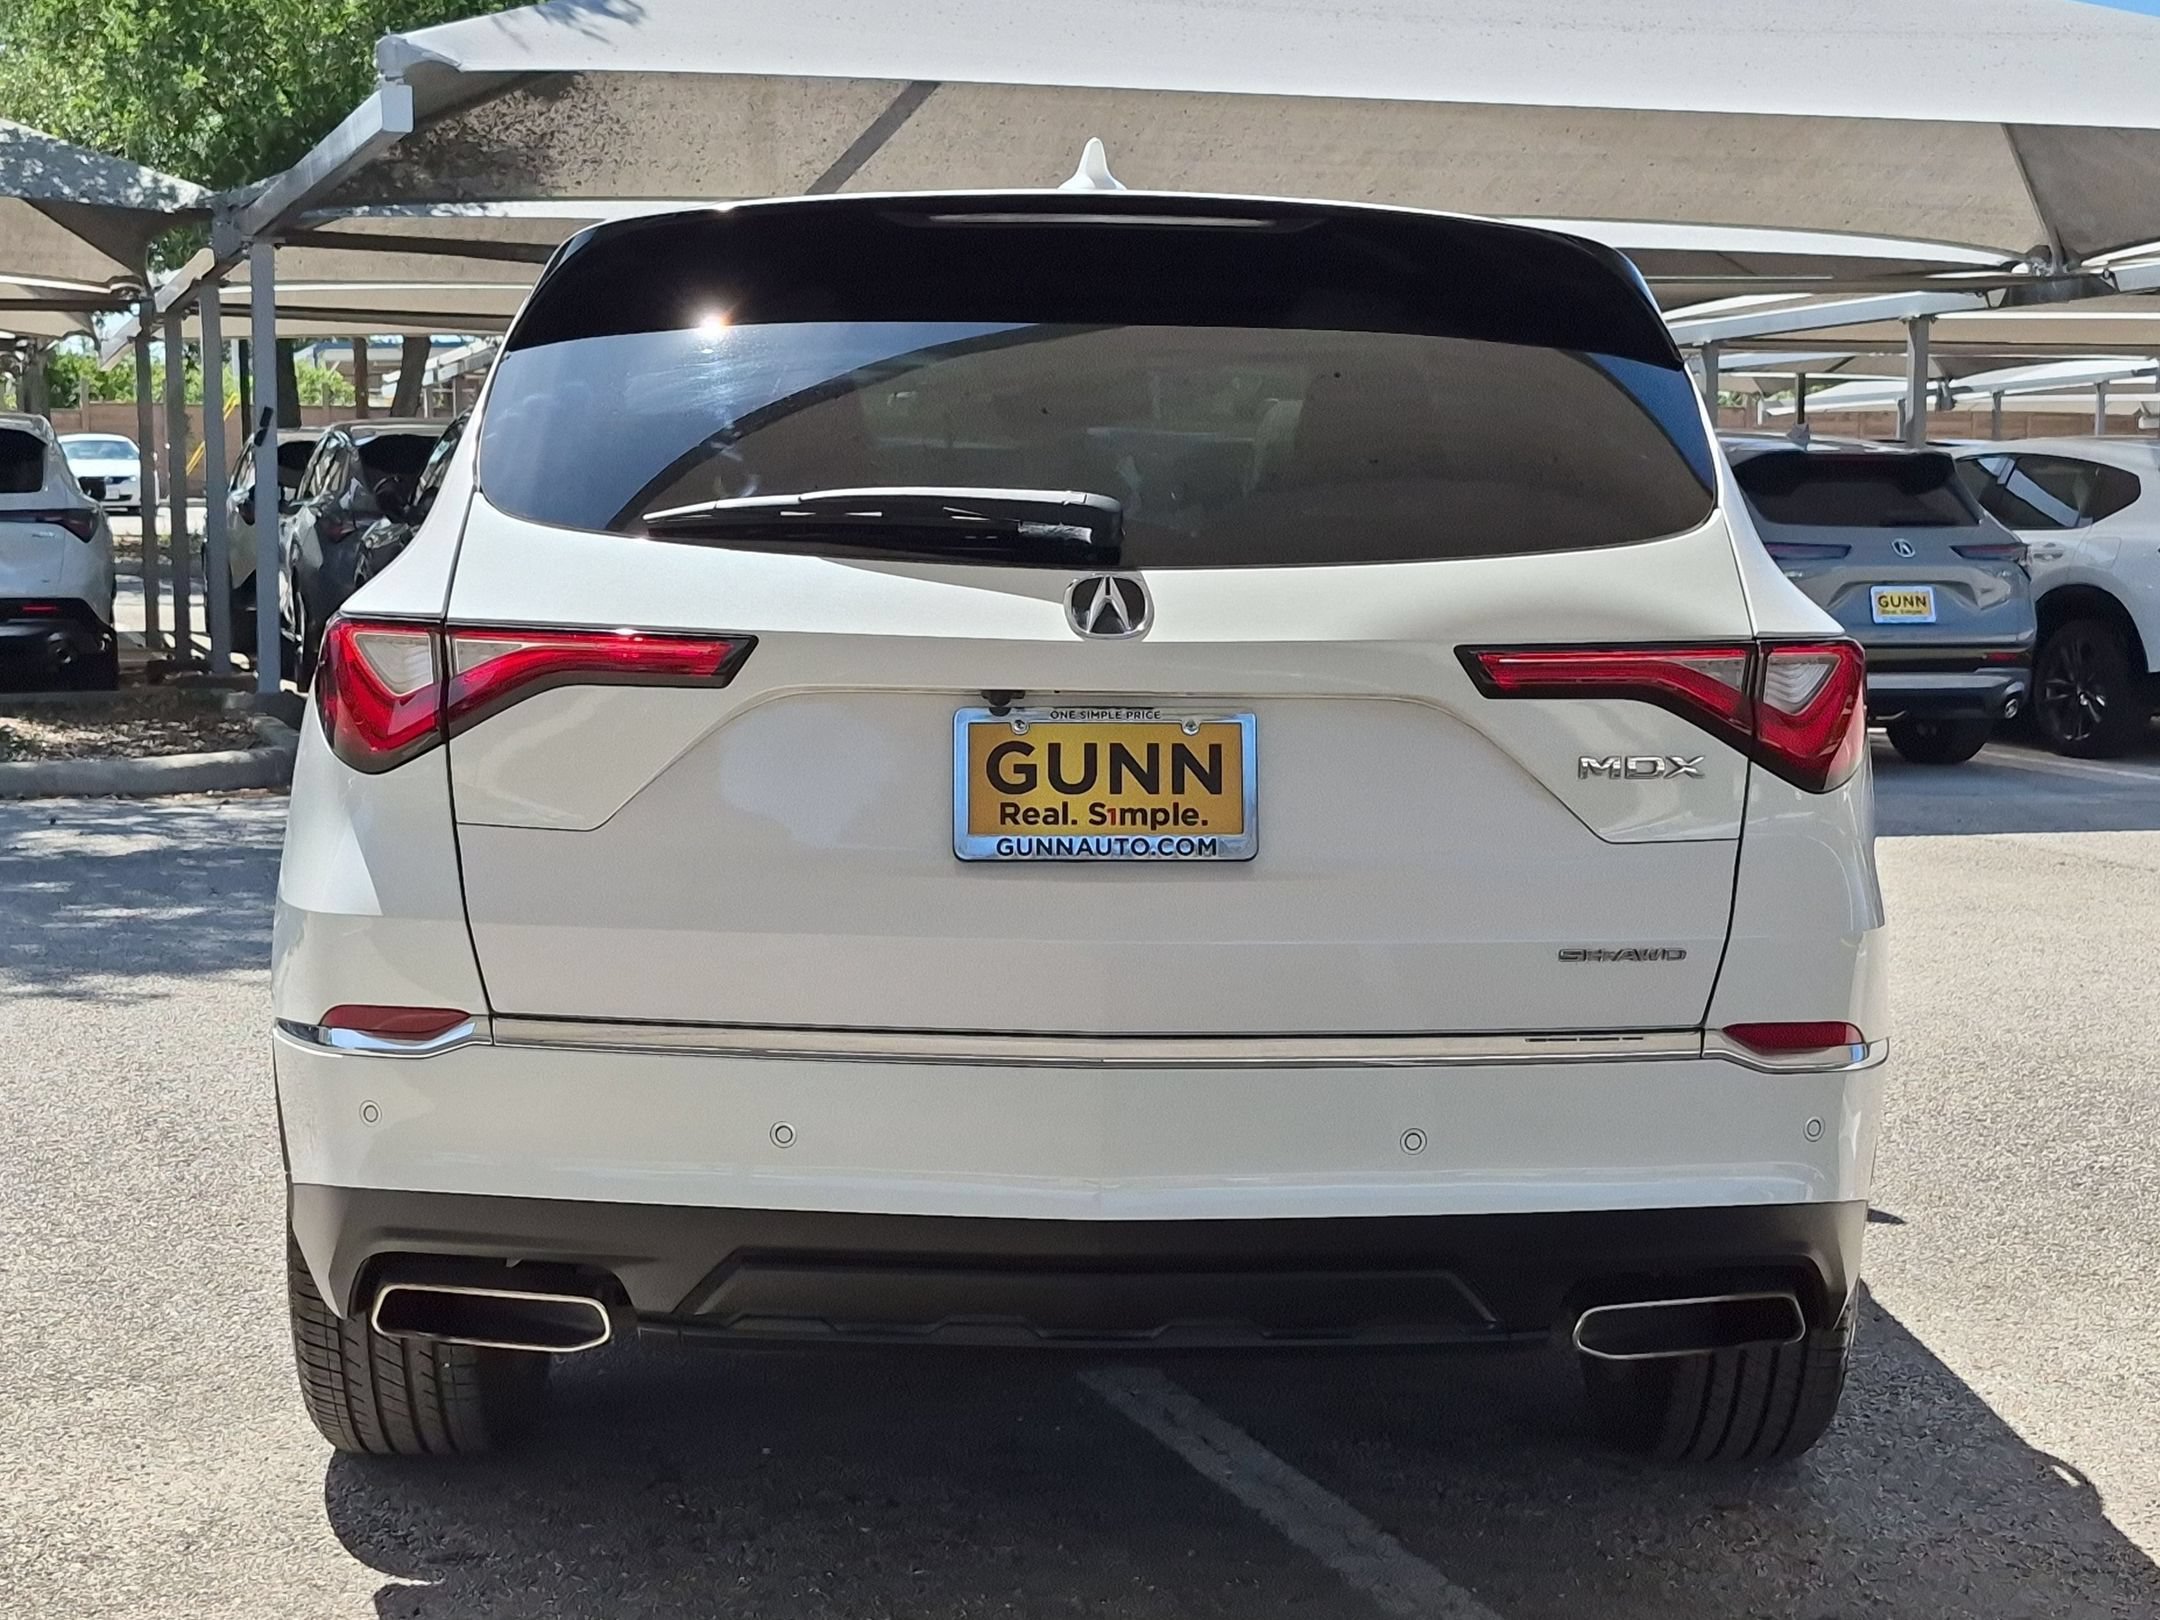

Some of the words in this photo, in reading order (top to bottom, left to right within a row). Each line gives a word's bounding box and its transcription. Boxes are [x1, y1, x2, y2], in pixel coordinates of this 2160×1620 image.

[1877, 594, 1927, 608] GUNN
[1050, 710, 1076, 720] ONE
[1079, 710, 1122, 720] SIMPLE
[1126, 710, 1161, 720] PRICE
[986, 740, 1222, 795] GUNN
[1578, 755, 1706, 779] MDX
[1000, 801, 1078, 826] Real.
[996, 837, 1218, 857] GUNNAUTO.COM
